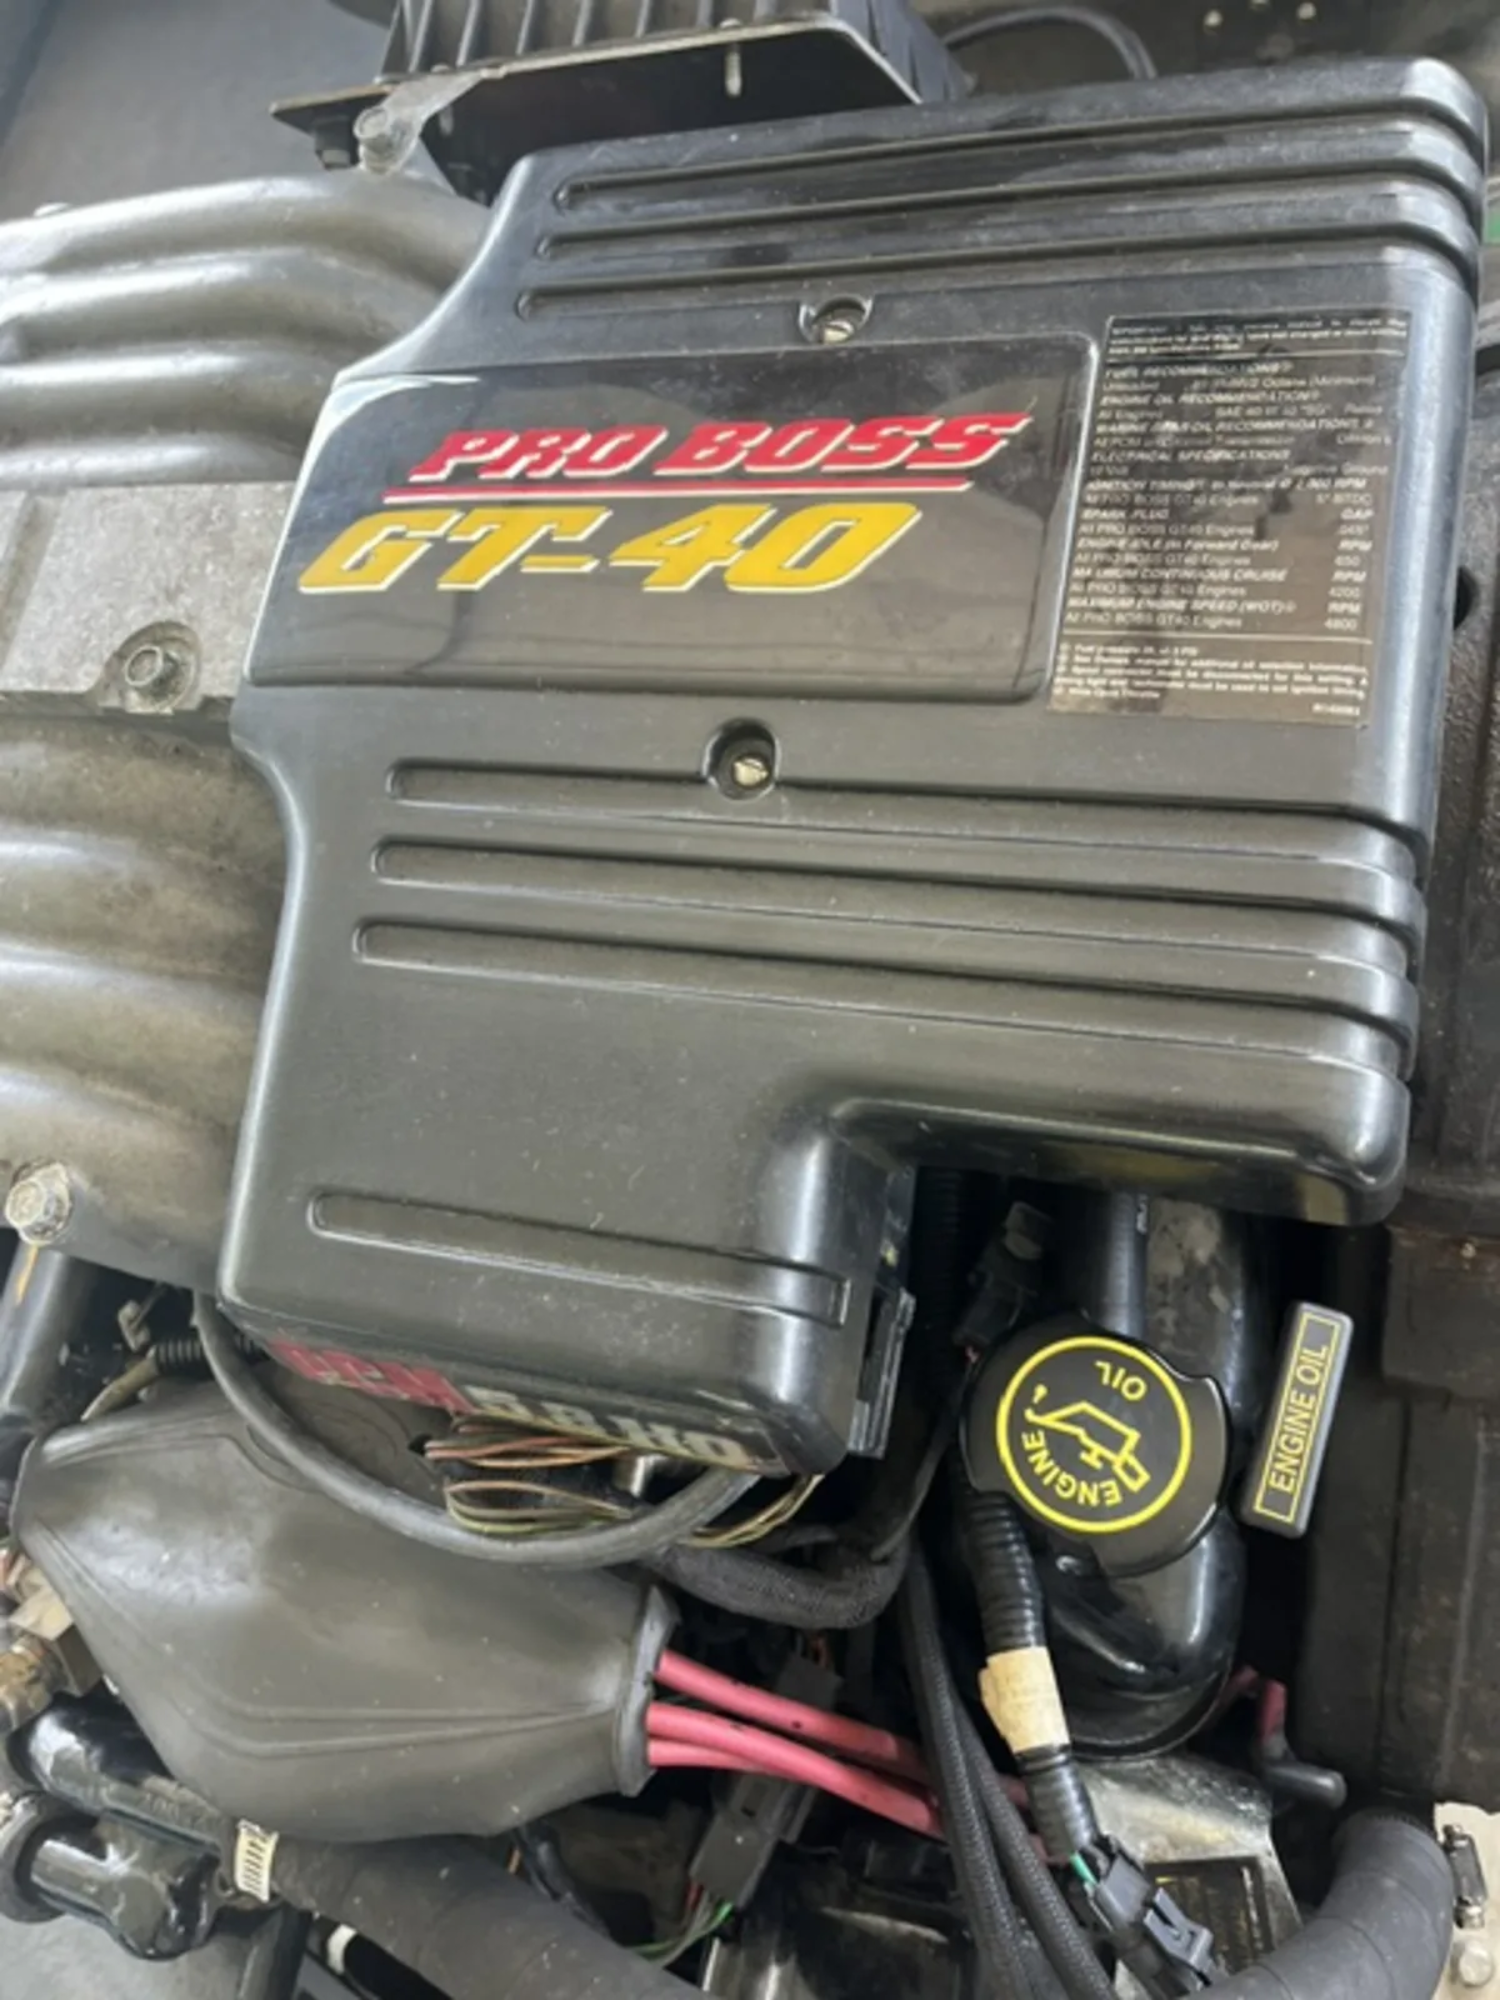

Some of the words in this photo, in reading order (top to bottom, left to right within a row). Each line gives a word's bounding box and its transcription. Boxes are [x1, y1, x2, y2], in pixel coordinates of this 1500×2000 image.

[408, 428, 667, 482] PRO
[654, 413, 1032, 476] BOSS
[1340, 508, 1375, 520] GAP
[299, 502, 922, 593] GT-40
[1338, 539, 1373, 551] RPM
[1233, 568, 1289, 582] CRUISE
[1331, 570, 1368, 583] RPM
[1327, 601, 1362, 614] RPM
[1094, 1360, 1147, 1400] OIL
[1268, 1391, 1316, 1495] ENGINE
[1296, 1345, 1328, 1386] OIL
[1021, 1429, 1123, 1507] ENGINE
